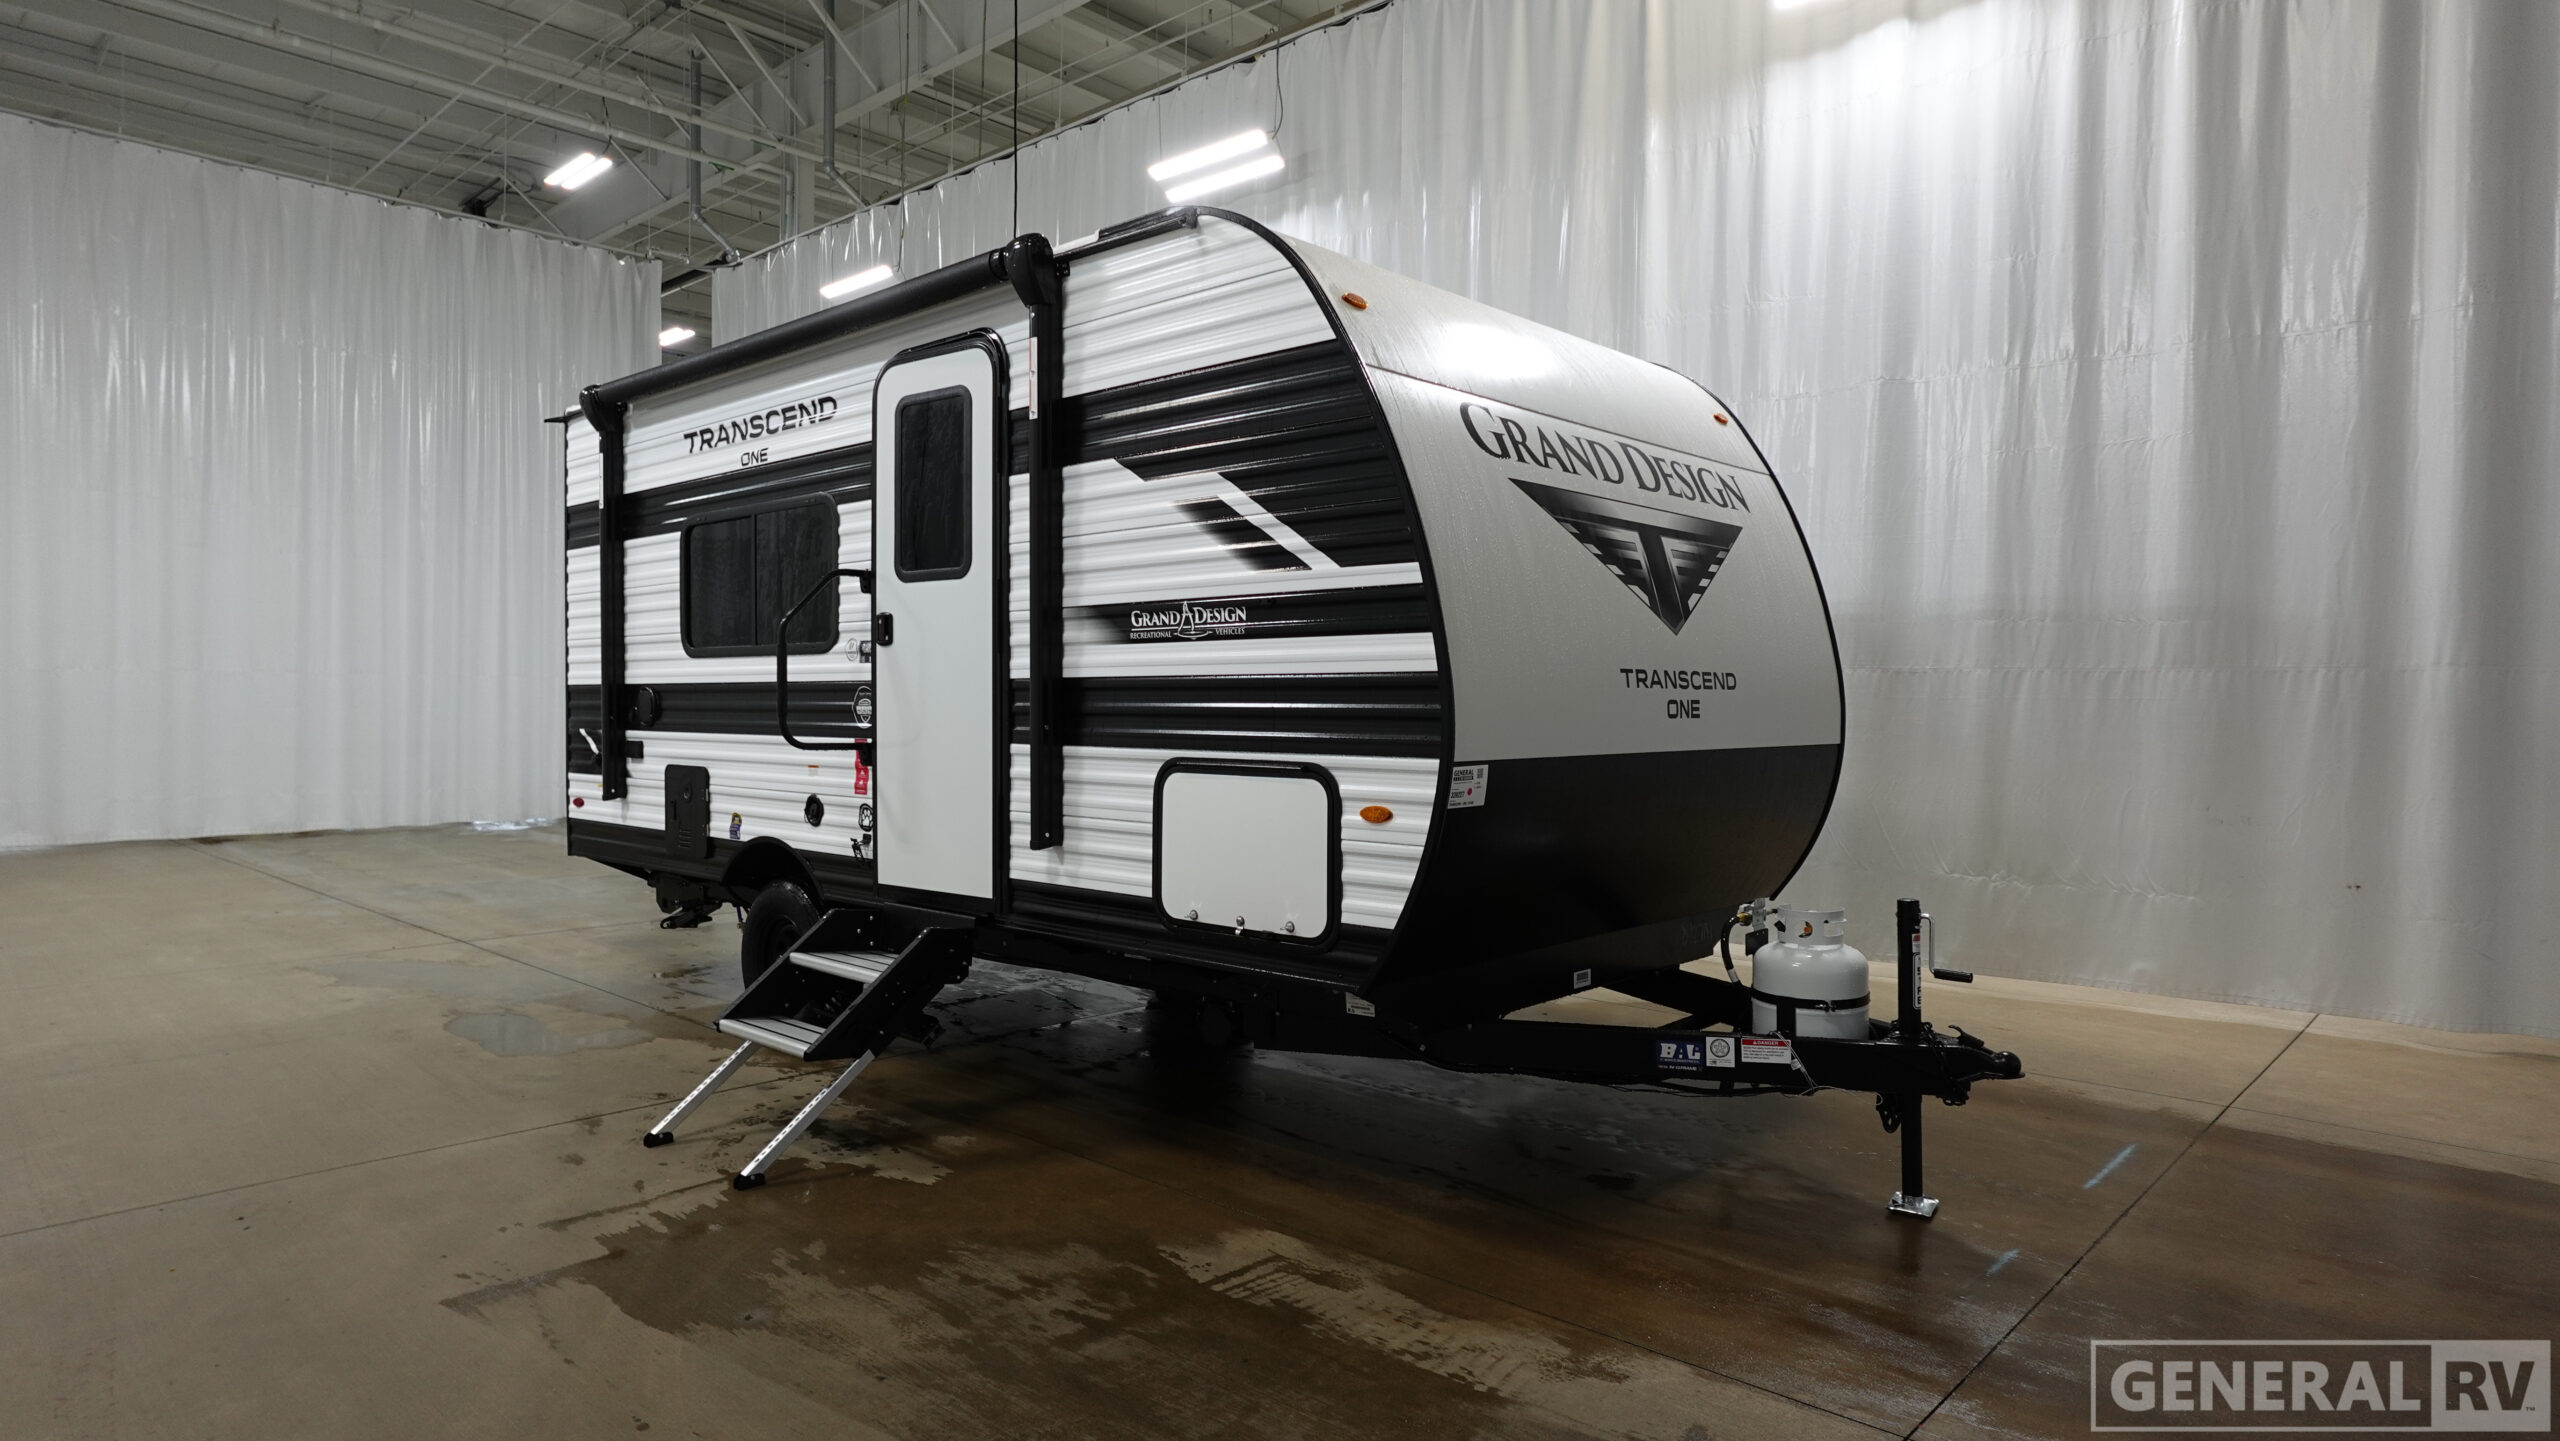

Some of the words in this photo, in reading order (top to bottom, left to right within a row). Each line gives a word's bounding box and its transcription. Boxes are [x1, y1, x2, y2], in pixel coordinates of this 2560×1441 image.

[683, 396, 838, 454] TRANSCEND
[740, 447, 769, 467] ONE
[1459, 401, 1624, 485] GRAND
[1618, 440, 1751, 513] DESIGN
[1131, 610, 1180, 627] GRAND
[1193, 606, 1247, 624] DESIGN
[1130, 631, 1172, 639] RECREATIONAL
[1215, 627, 1245, 636] VEHICLES
[1620, 668, 1737, 691] TRANSCEND
[1667, 699, 1701, 719] ONE
[1660, 1042, 1701, 1060] BAL
